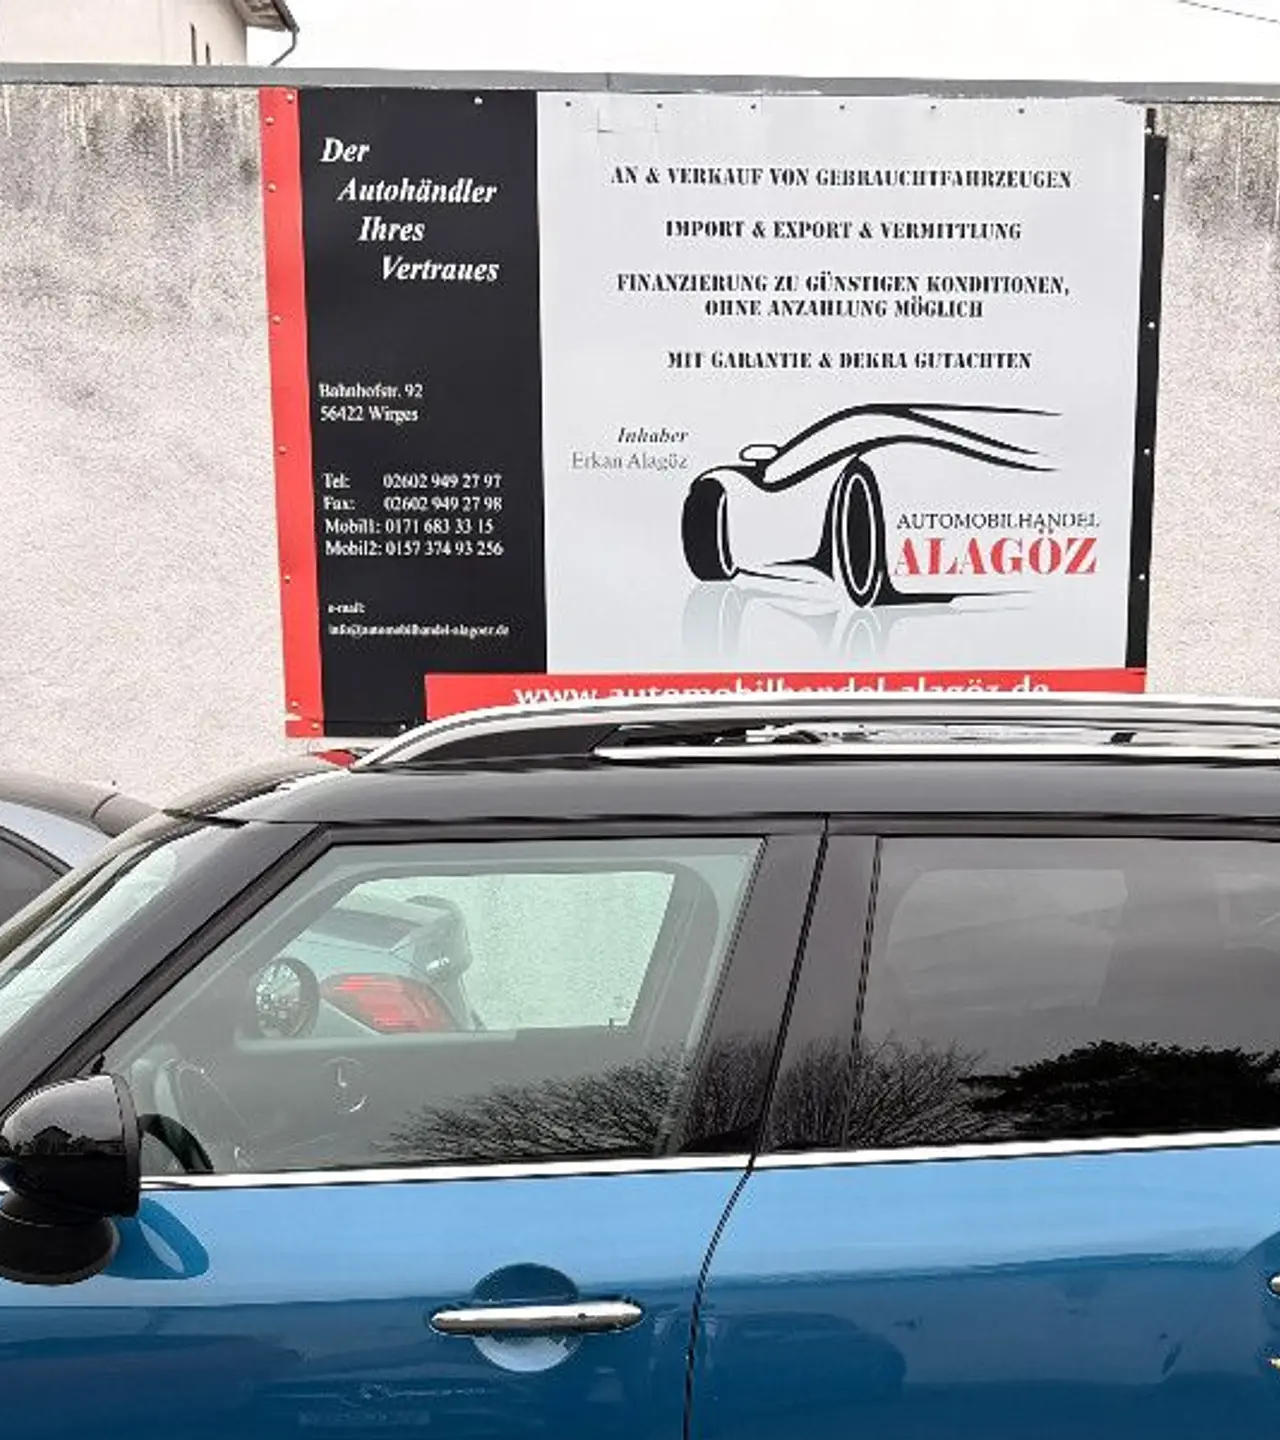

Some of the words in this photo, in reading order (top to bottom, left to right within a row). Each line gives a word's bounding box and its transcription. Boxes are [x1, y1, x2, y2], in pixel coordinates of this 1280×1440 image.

[320, 137, 370, 162] Der
[611, 166, 638, 184] AN
[645, 167, 660, 184] &
[667, 167, 764, 186] VERKAUF
[770, 168, 810, 186] VON
[816, 168, 1072, 188] GEBRAUCHTFAHRZEUGEN
[337, 176, 498, 203] Autohändler
[357, 216, 426, 241] Ihres
[665, 220, 745, 237] IMPORT
[752, 221, 766, 239] &
[773, 221, 853, 239] EXPORT
[858, 222, 873, 239] &
[880, 222, 1022, 240] VERMITTLUNG
[381, 255, 500, 281] Vertraues
[617, 273, 767, 292] FINANZIERUNG
[774, 275, 798, 292] ZU
[805, 271, 920, 293] GÜNSTIGEN
[927, 275, 1070, 296] KONDITIONEN,
[705, 299, 761, 316] OHNE
[767, 299, 887, 317] ANZAHLUNG
[894, 295, 983, 318] MÖGLICH
[667, 352, 702, 368] MIT
[711, 352, 812, 369] GARANTIE
[818, 352, 832, 369] &
[839, 352, 908, 369] DEKRA
[914, 352, 1032, 369] GUTACHTEN
[319, 382, 401, 398] Bahnhofstr.
[404, 383, 423, 398] 92
[320, 405, 364, 421] 56422
[368, 405, 419, 425] Wirges
[618, 427, 689, 443] Inhaber
[572, 452, 622, 469] Erkan
[627, 453, 688, 471] Alagöz
[323, 473, 351, 489] Tel:
[383, 473, 428, 489] 02602
[431, 473, 458, 489] 949
[462, 473, 480, 489] 27
[483, 473, 502, 489] 97
[323, 496, 355, 511] Fax:
[383, 496, 428, 511] 02602
[431, 496, 458, 511] 949
[462, 496, 480, 512] 27
[483, 496, 502, 511] 98
[385, 518, 419, 534] 0171
[424, 518, 450, 534] 683
[455, 518, 472, 534] 33
[478, 518, 493, 534] 15
[897, 513, 1100, 529] AUTOMOBILHANDEL
[325, 540, 382, 556] Mobil2:
[385, 540, 420, 556] 0157
[424, 540, 452, 556] 374
[455, 540, 473, 556] 93
[477, 540, 504, 556] 256
[894, 527, 1097, 575] ALAGÖZ
